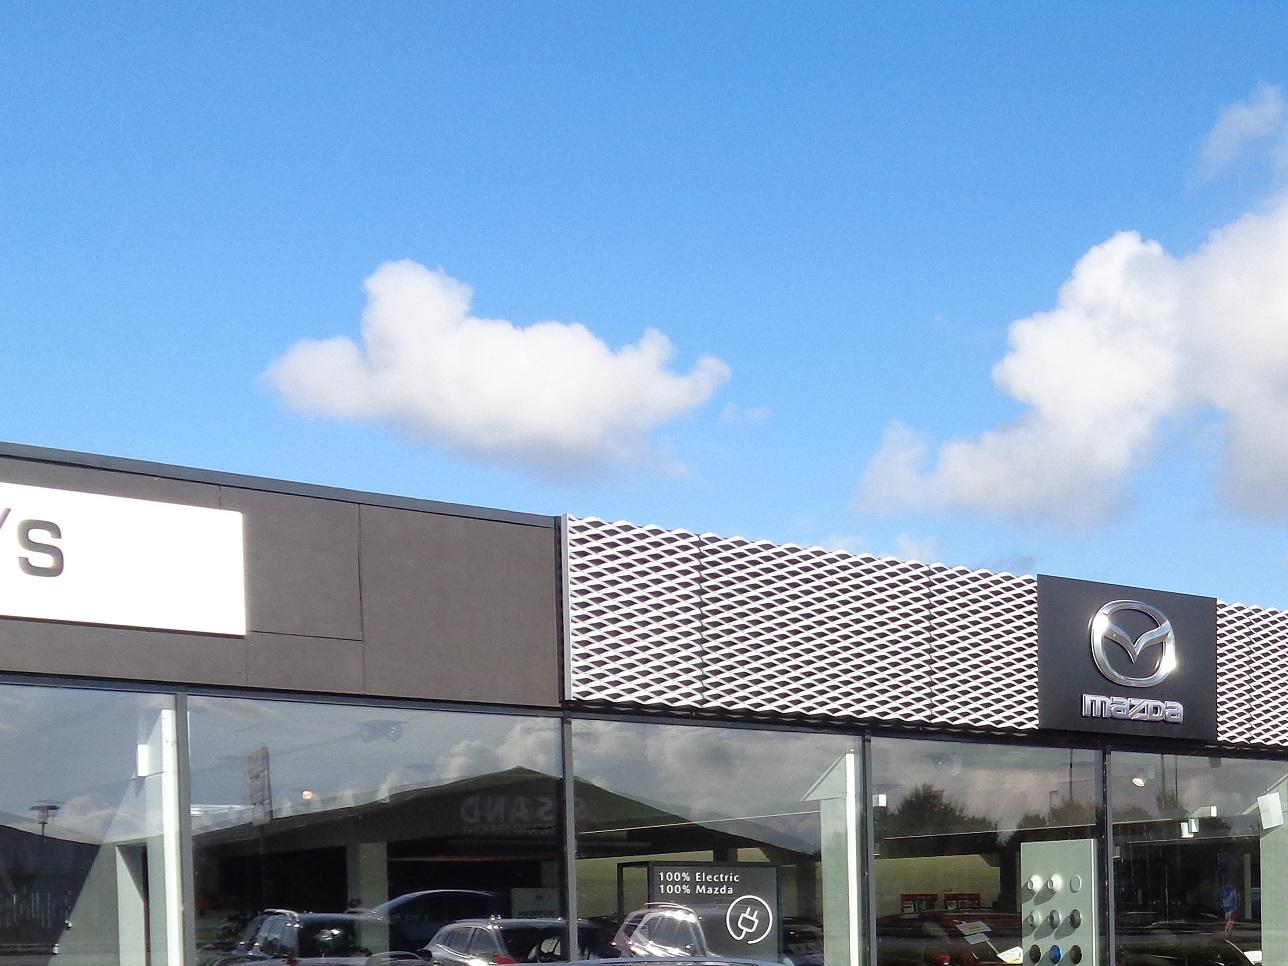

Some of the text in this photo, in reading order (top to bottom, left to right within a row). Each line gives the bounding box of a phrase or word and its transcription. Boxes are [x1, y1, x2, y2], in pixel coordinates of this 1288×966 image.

[1082, 693, 1184, 723] mazda
[659, 872, 740, 882] 100% Electric
[659, 884, 733, 894] 100% Mazda
